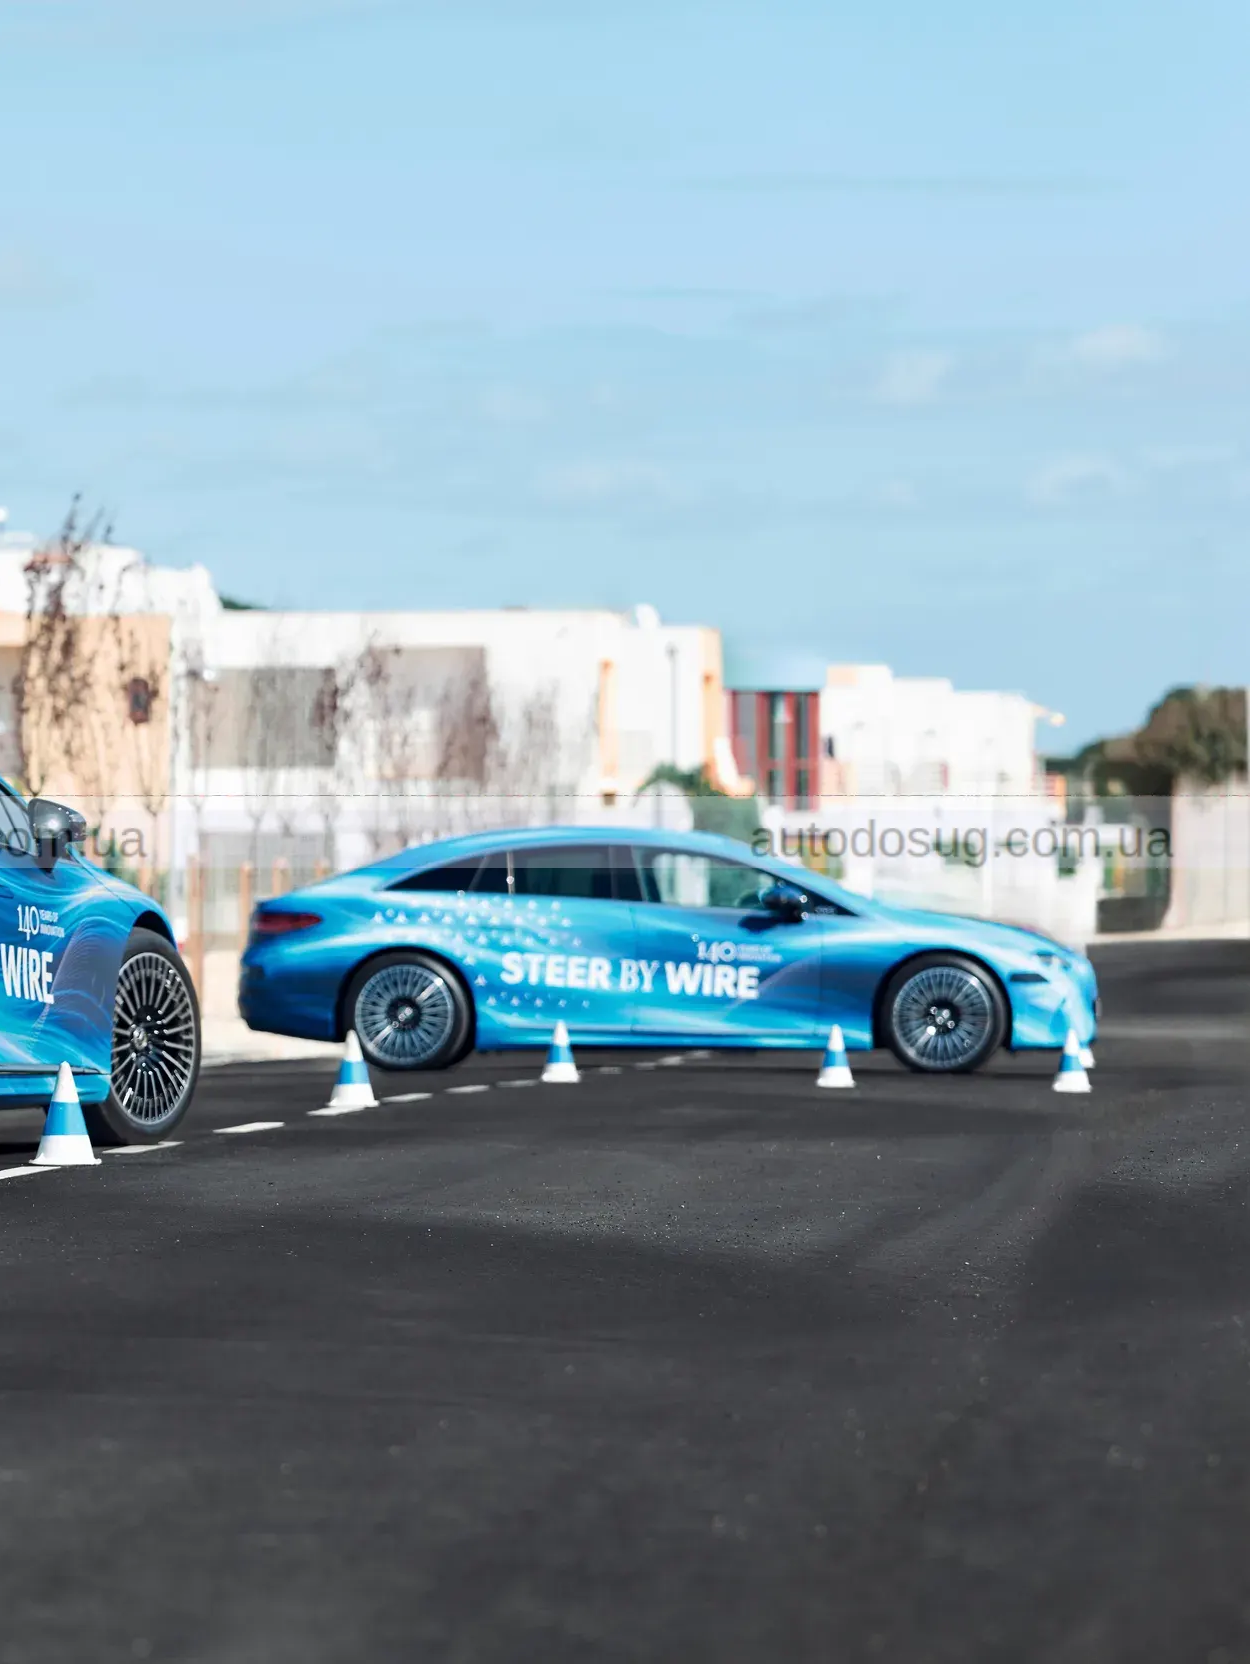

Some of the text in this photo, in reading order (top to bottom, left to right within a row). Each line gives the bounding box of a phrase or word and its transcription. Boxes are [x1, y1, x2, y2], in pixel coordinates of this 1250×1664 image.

[17, 904, 40, 941] 140
[0, 943, 54, 1004] WIRE
[696, 940, 736, 964] 140
[500, 951, 760, 1000] STEER BY WIRE
